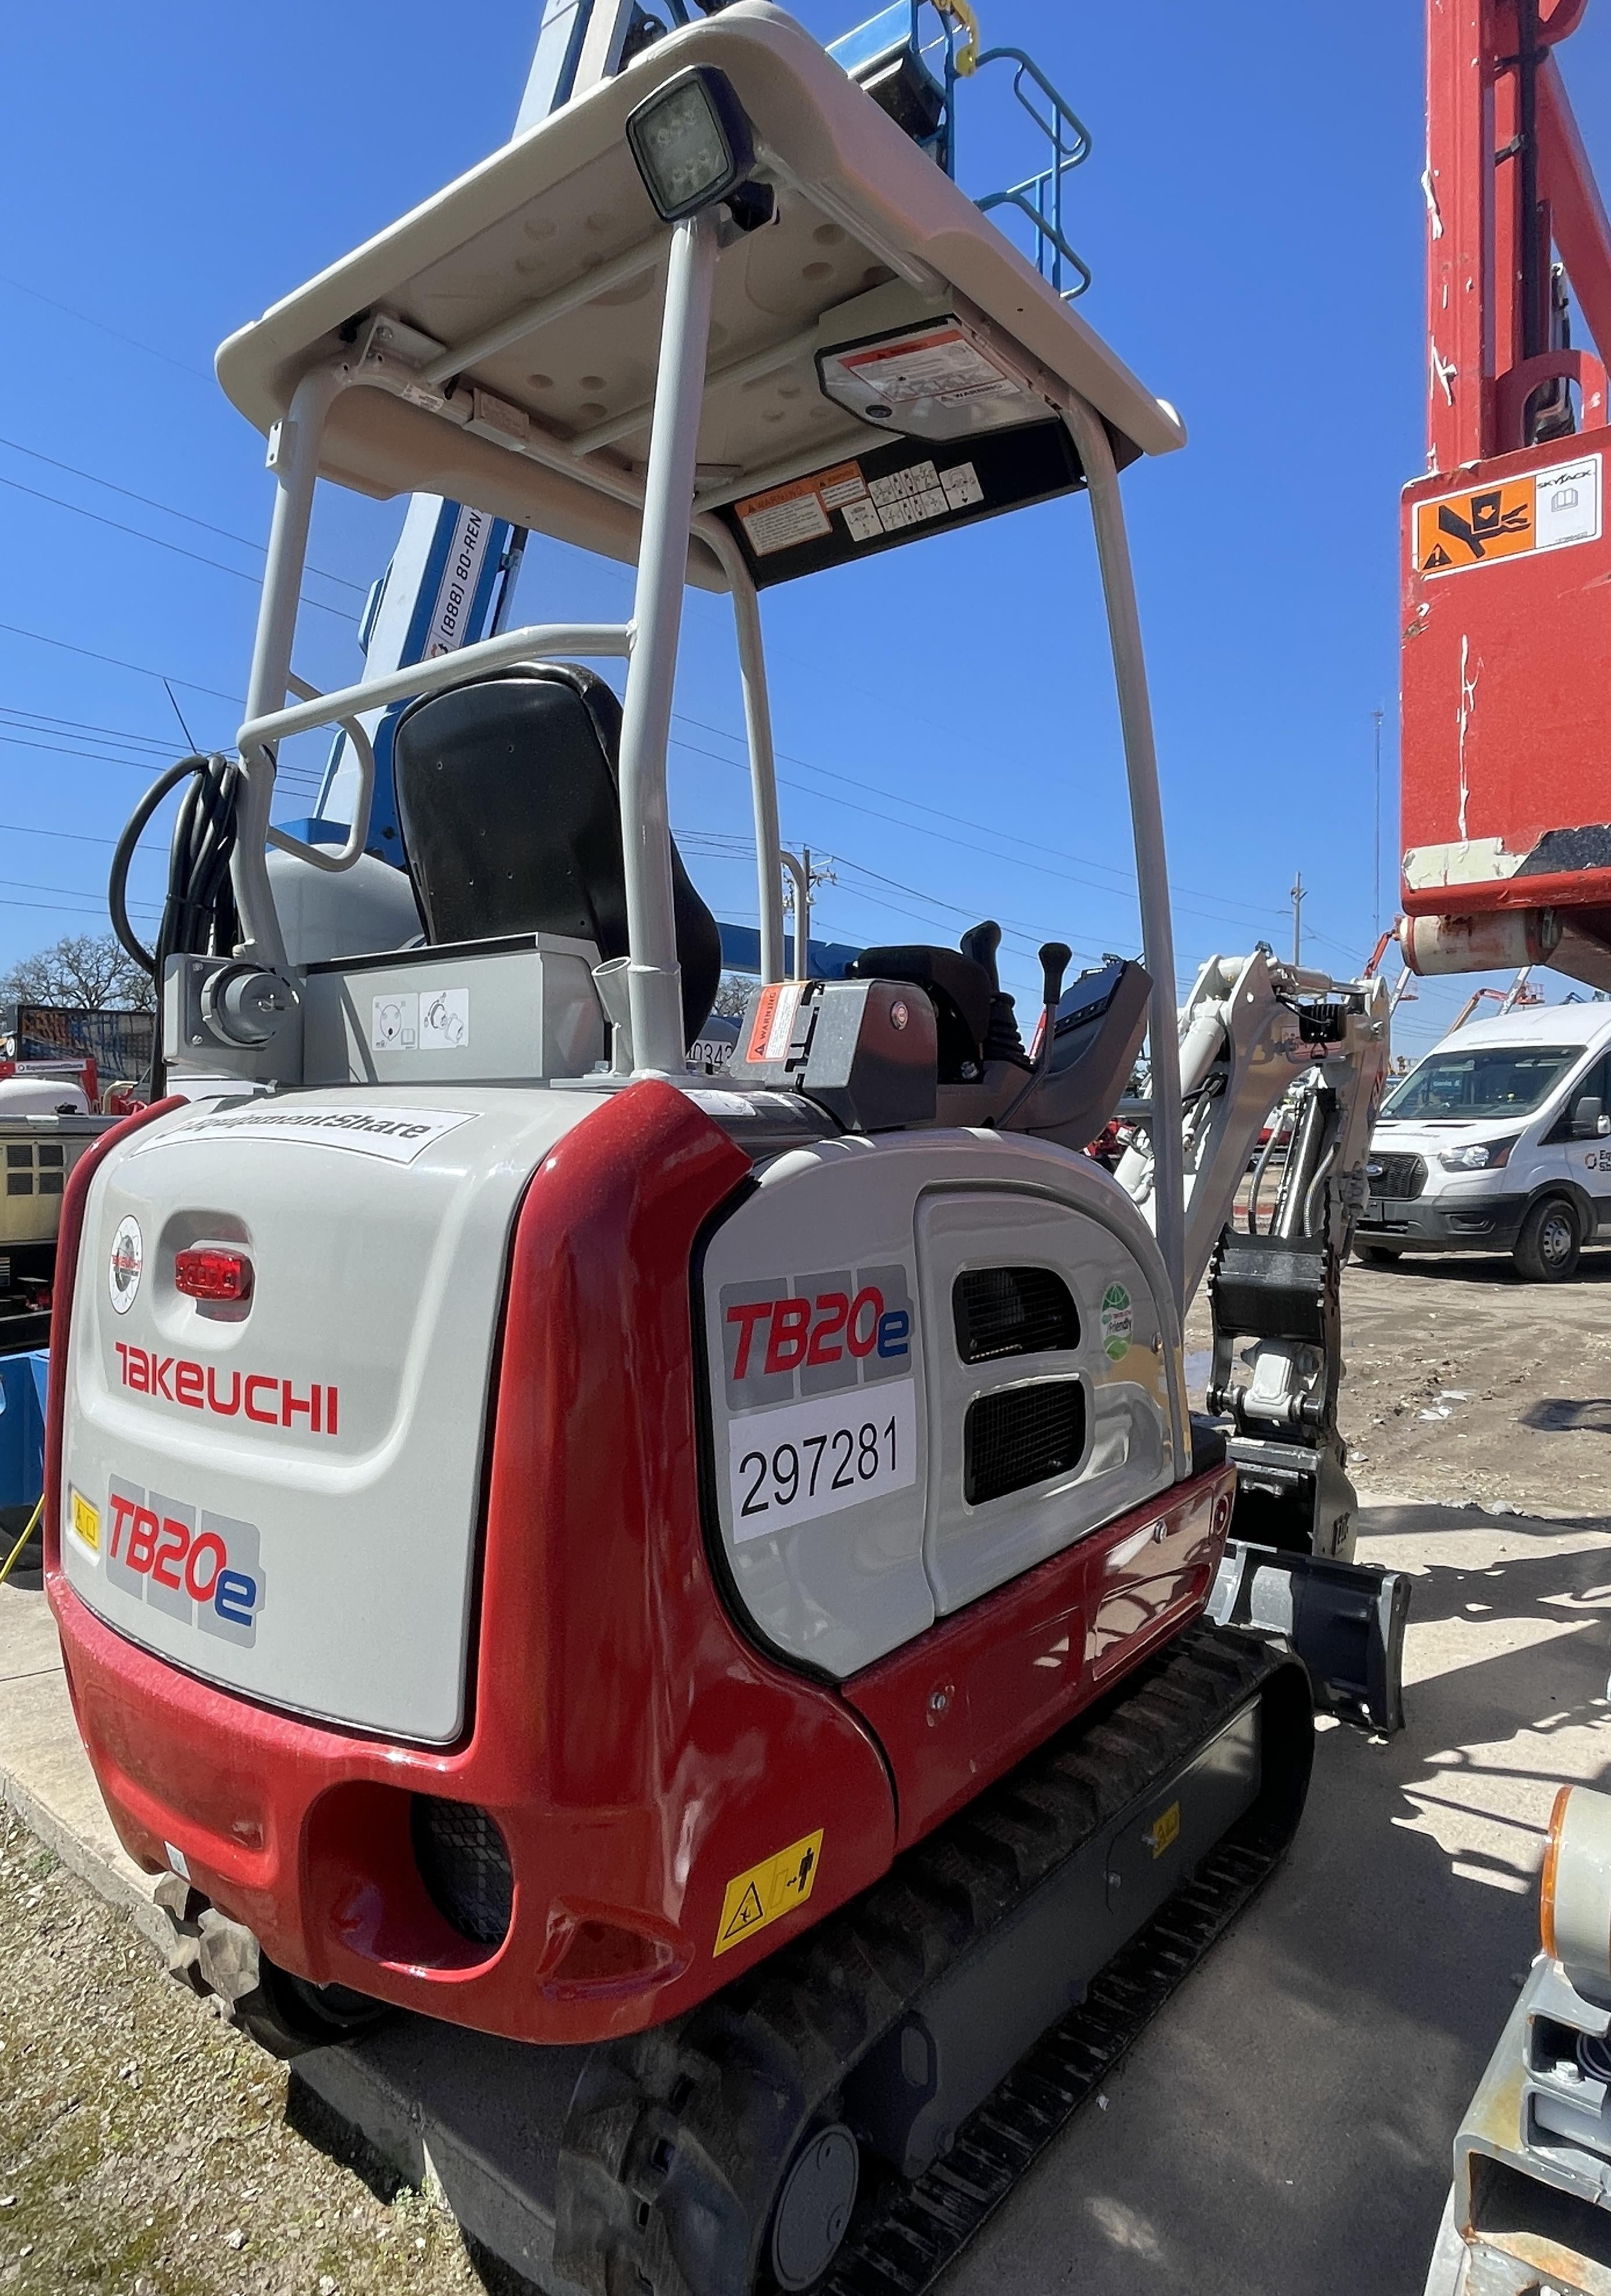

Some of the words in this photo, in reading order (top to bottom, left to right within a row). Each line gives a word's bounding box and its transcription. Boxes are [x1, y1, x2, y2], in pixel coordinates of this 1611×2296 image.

[1537, 470, 1592, 489] SKYJACK
[441, 582, 465, 637] (888)
[759, 991, 777, 1039] WARNING
[192, 1113, 432, 1139] EquipmentShare
[726, 1286, 909, 1380] TB20e
[115, 1341, 338, 1436] TAKEUCHI
[739, 1415, 898, 1518] 297281
[110, 1493, 257, 1627] TB20e
